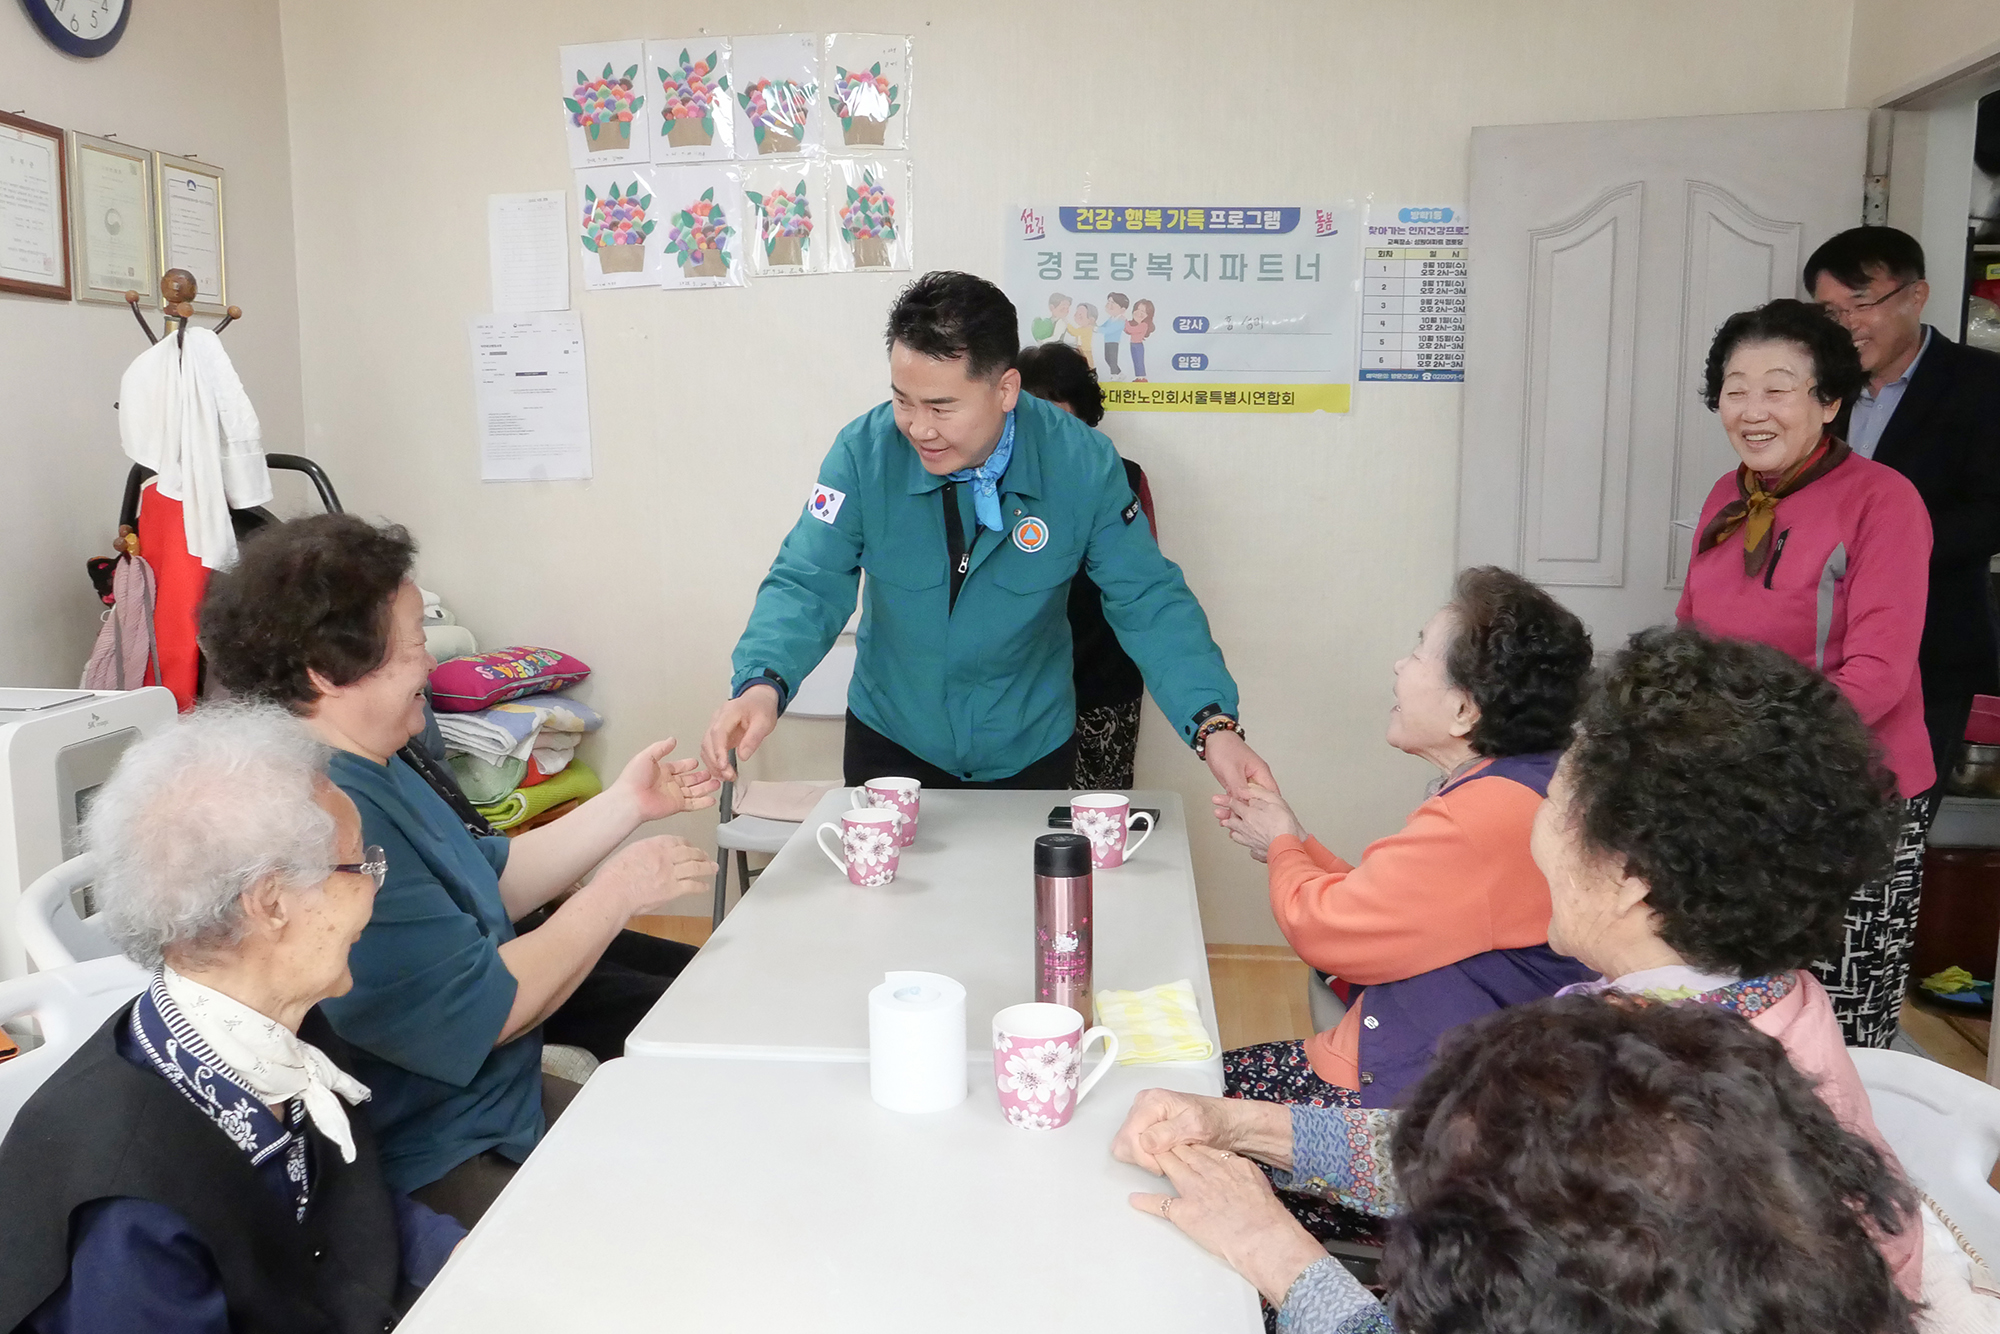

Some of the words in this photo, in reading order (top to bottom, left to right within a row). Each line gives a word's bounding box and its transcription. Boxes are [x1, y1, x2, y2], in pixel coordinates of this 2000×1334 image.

[70, 13, 79, 32] 6
[90, 10, 98, 28] 5
[1020, 208, 1045, 235] 섬김
[1166, 208, 1205, 231] 가득
[1208, 210, 1281, 230] 프로그램
[1315, 209, 1333, 234] 돌봄
[1368, 226, 1407, 236] 찾아가는
[1377, 250, 1394, 258] 회차
[1178, 318, 1204, 331] 강사
[1418, 342, 1432, 350] 오후
[1178, 355, 1202, 369] 일정
